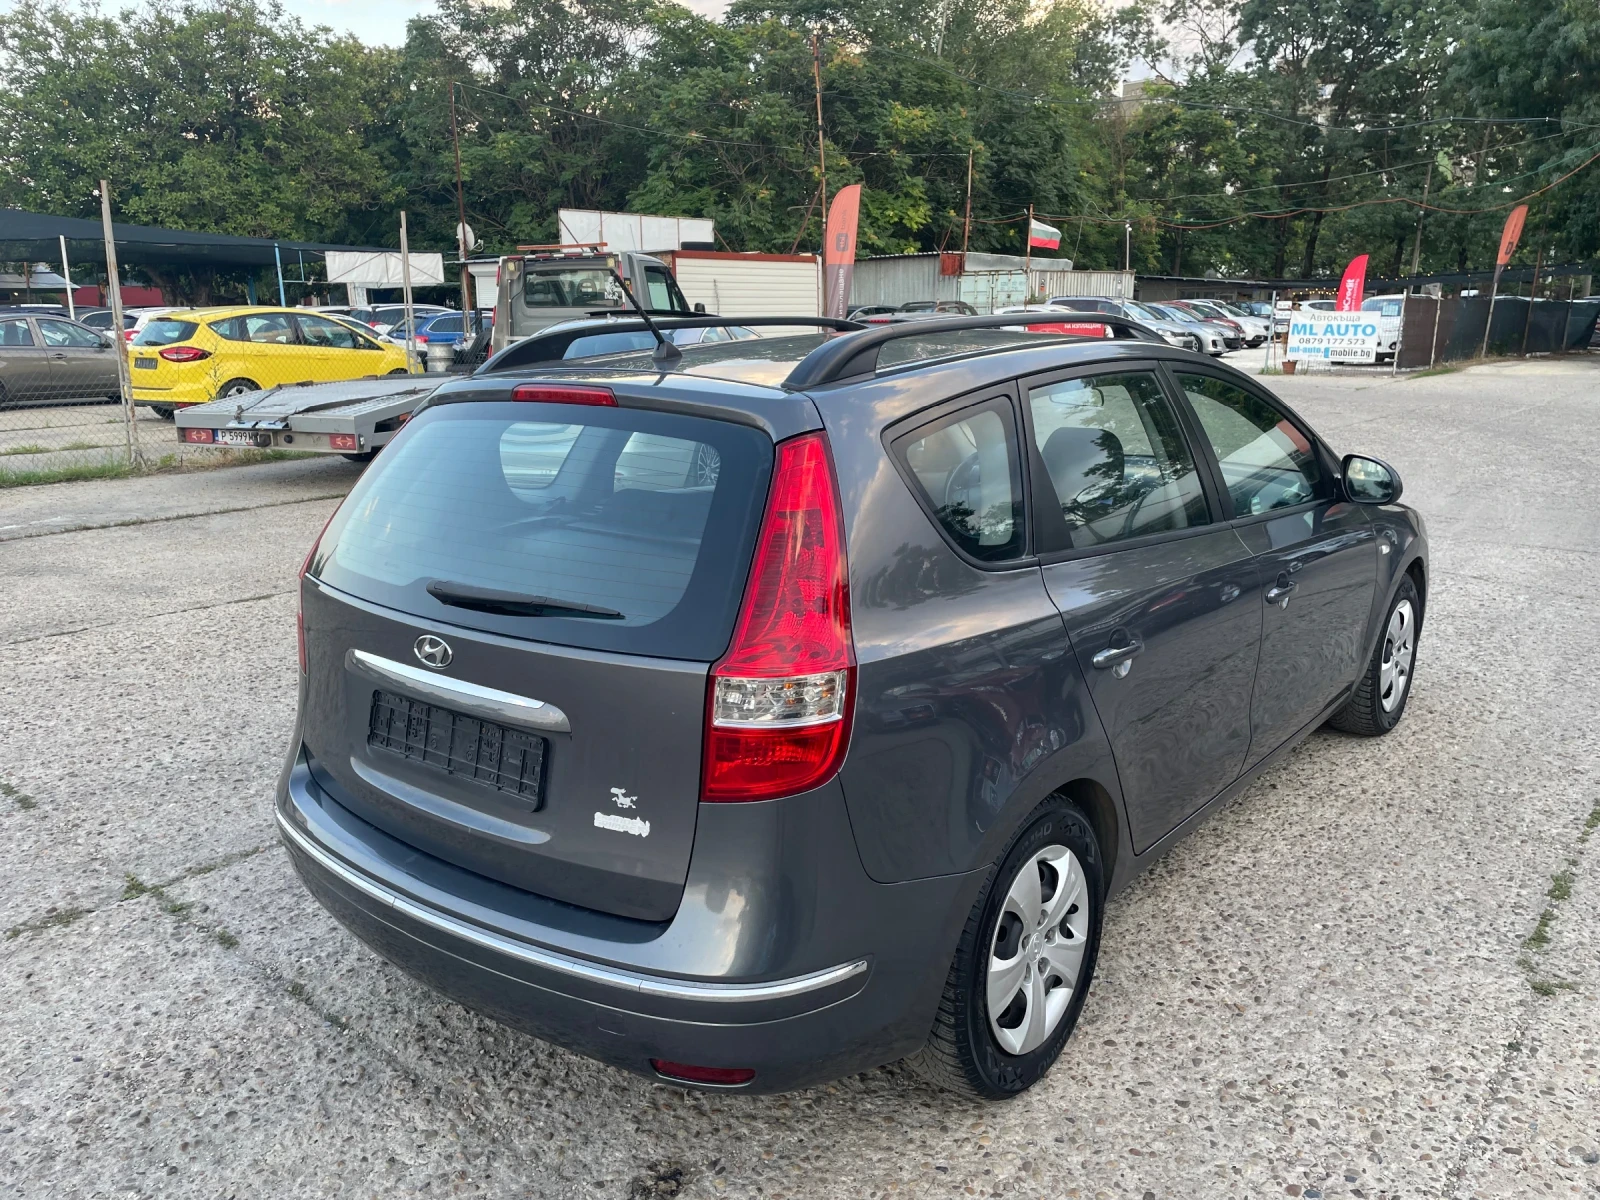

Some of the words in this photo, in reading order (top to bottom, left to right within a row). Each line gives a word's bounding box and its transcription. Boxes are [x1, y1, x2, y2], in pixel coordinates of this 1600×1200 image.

[1342, 279, 1355, 311] niCredit
[1309, 313, 1361, 322] Автокъща
[1291, 324, 1318, 336] ML
[1323, 324, 1376, 336] AUTO
[1298, 337, 1323, 345] 0879
